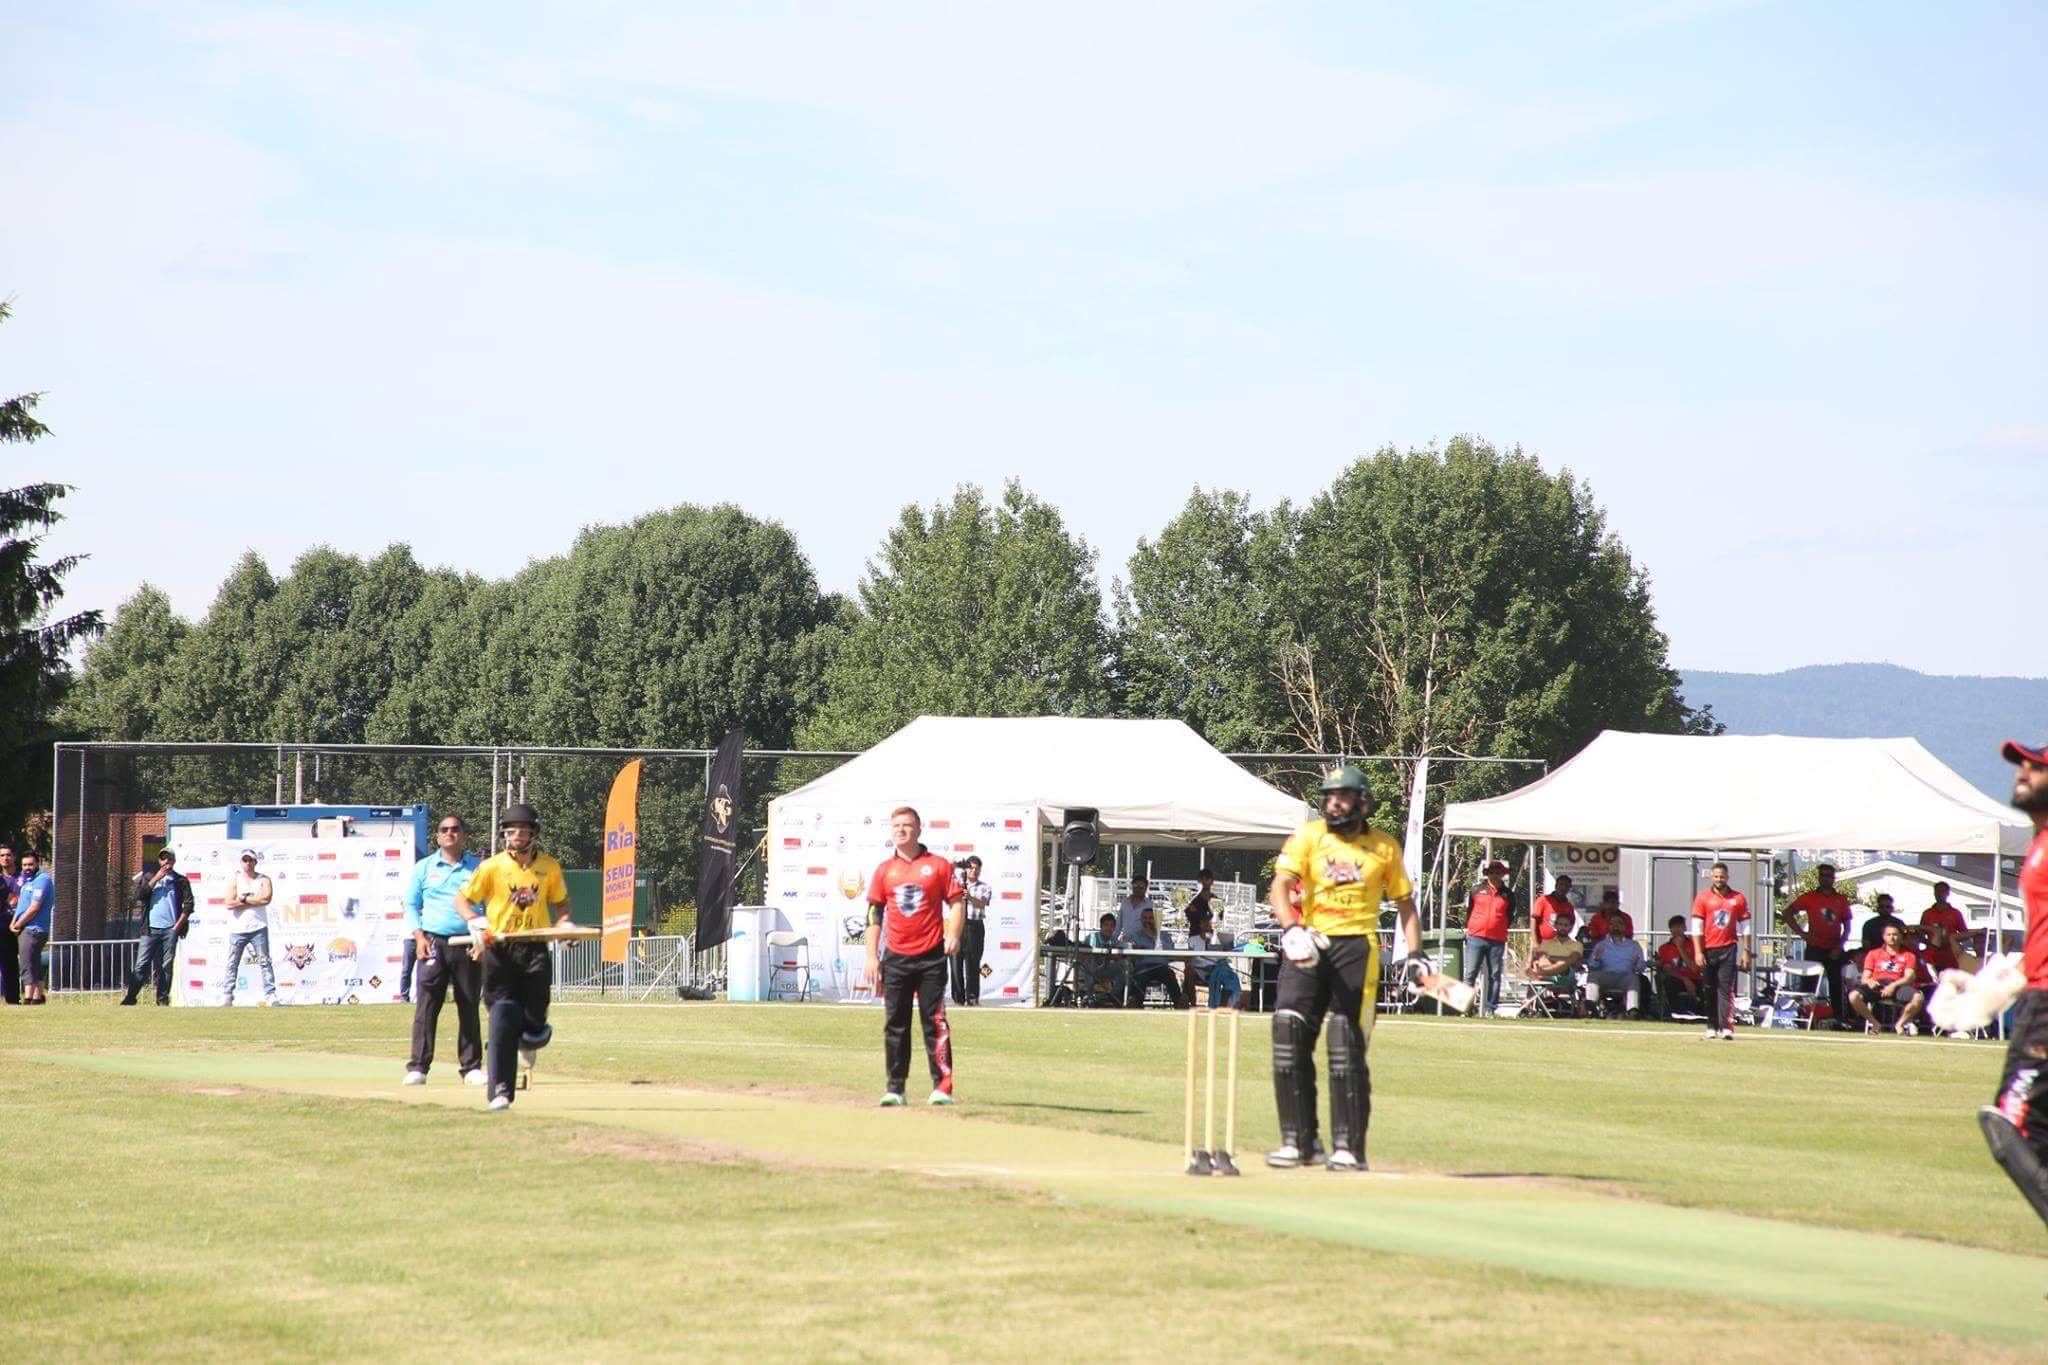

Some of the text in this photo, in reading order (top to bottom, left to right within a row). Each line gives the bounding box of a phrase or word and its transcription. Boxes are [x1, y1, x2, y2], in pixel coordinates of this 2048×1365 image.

[607, 822, 633, 851] Ria
[605, 863, 633, 882] SEND
[605, 880, 632, 894] MONEY
[283, 904, 338, 923] NPL
